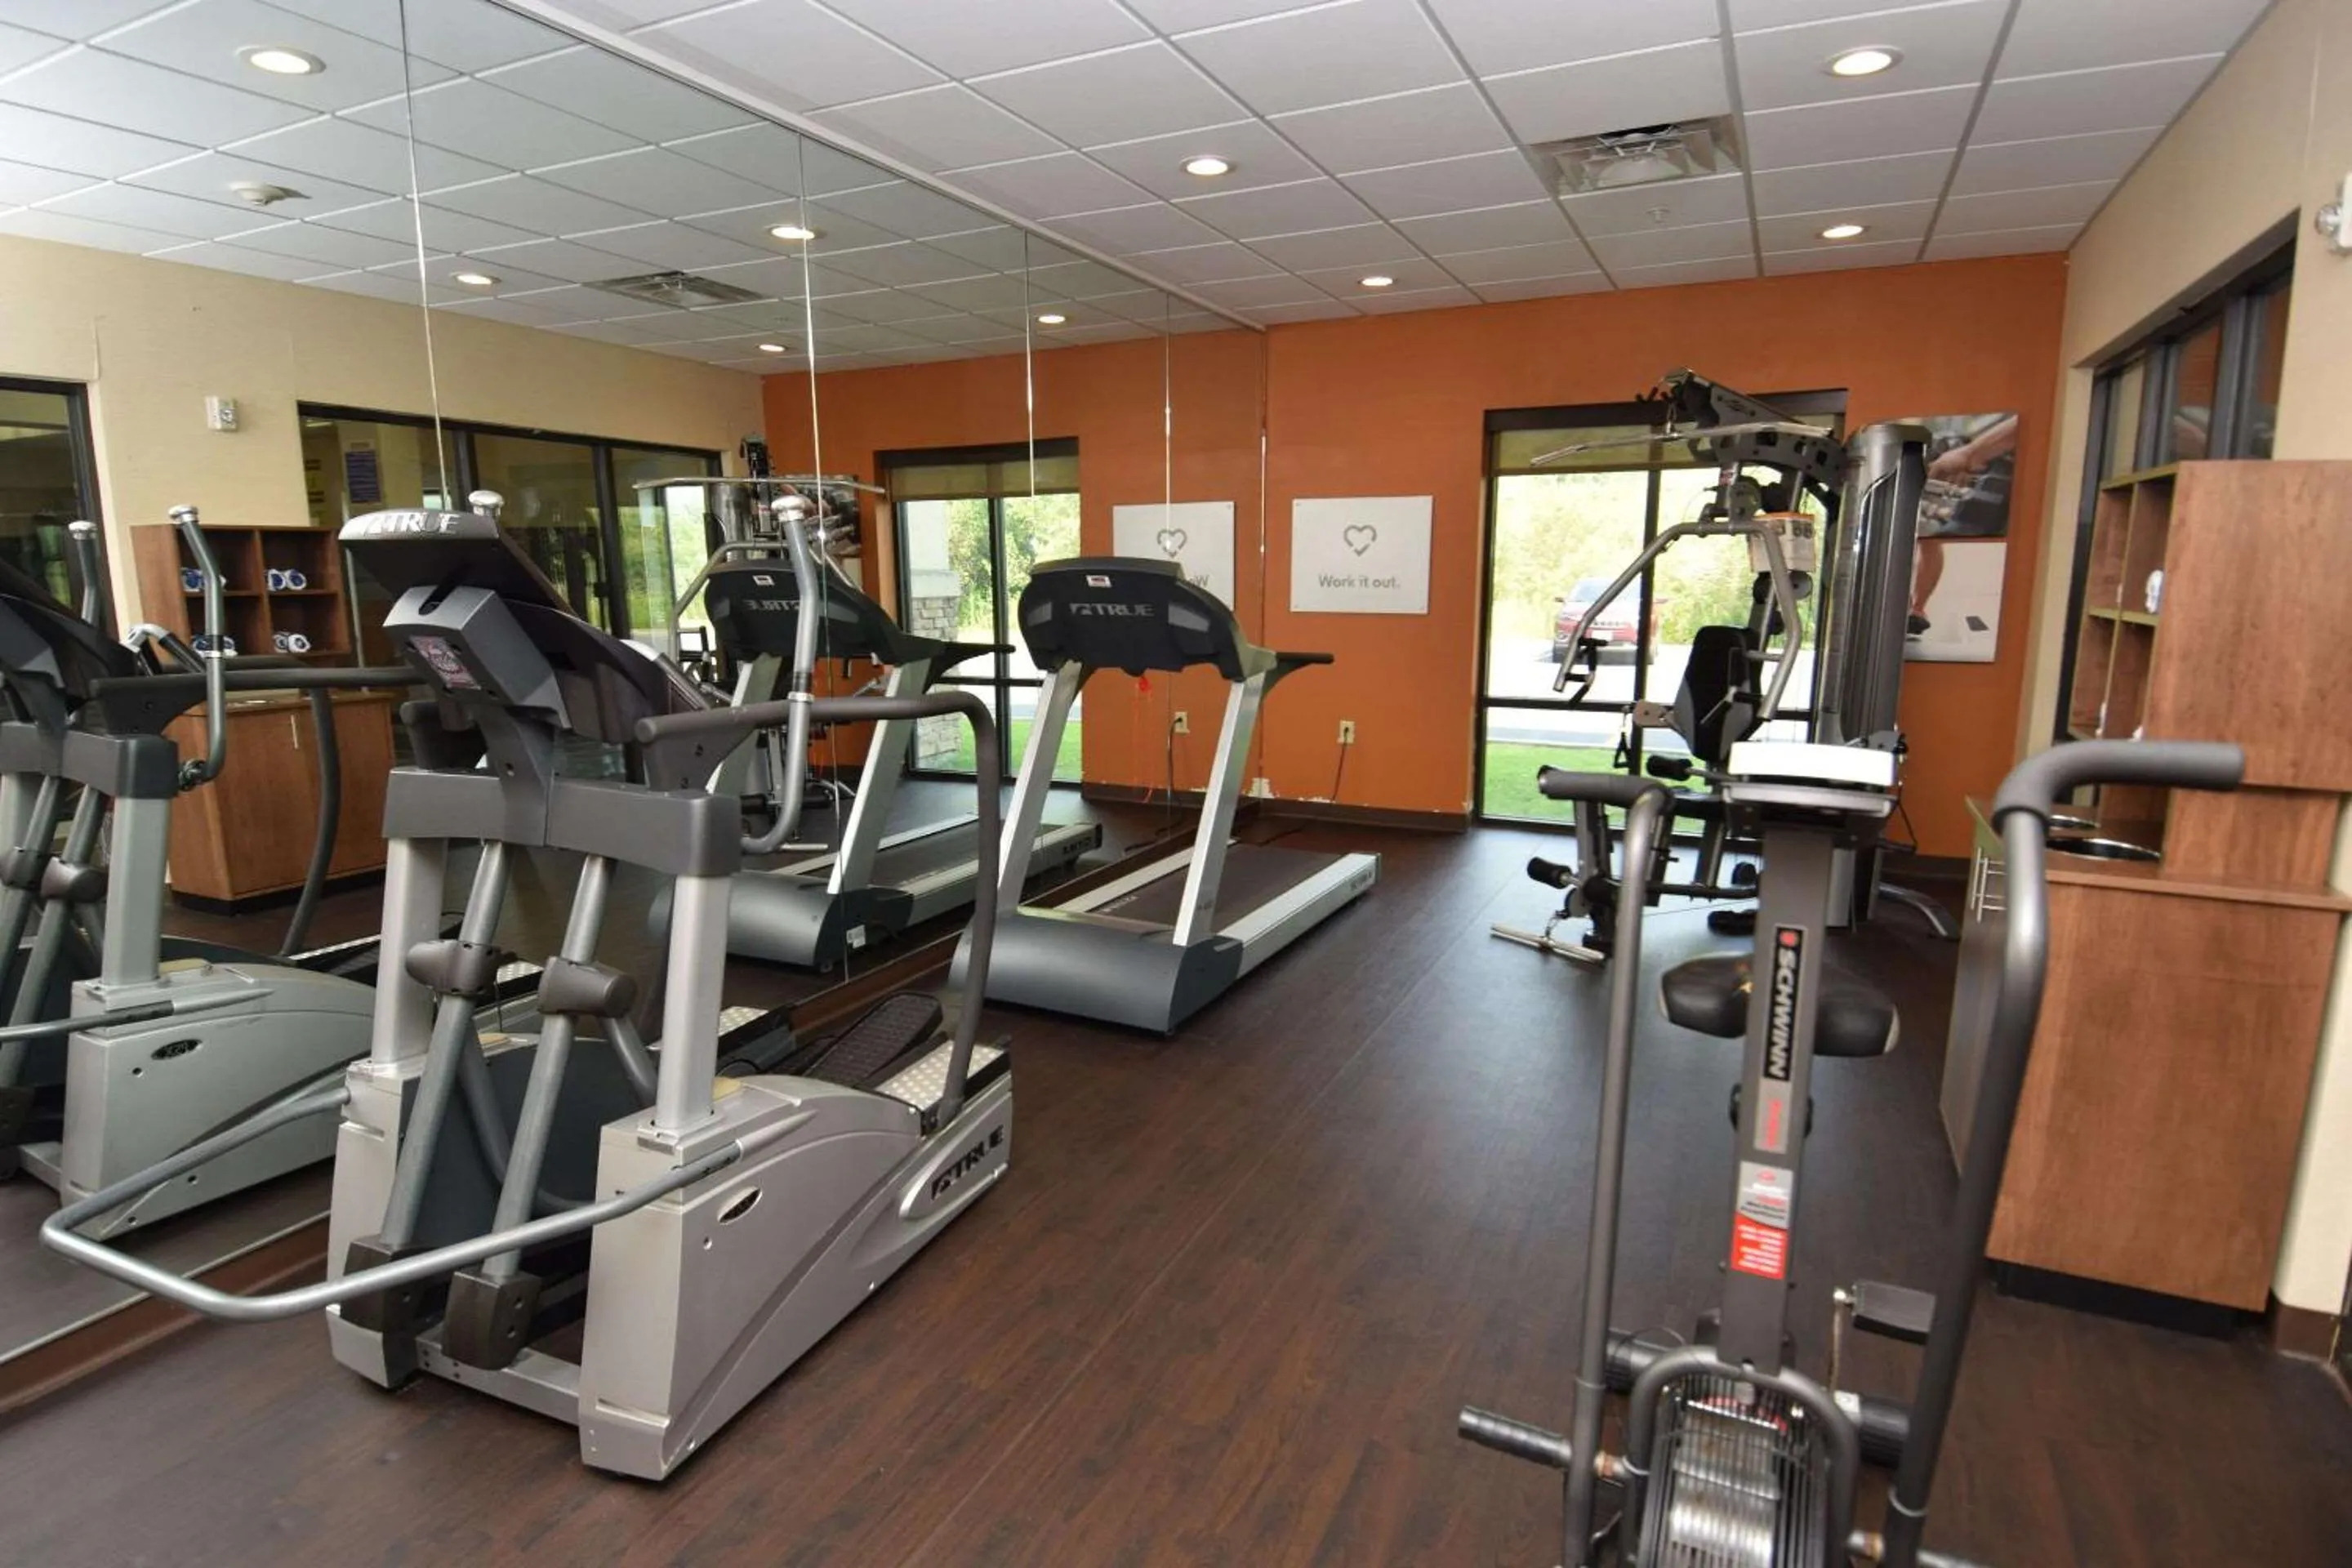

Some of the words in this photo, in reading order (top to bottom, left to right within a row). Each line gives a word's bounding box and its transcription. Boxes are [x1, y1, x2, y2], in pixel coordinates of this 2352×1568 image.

[1318, 574, 1356, 588] Work
[1359, 575, 1369, 588] it
[1372, 576, 1401, 589] out.
[1091, 603, 1155, 617] TRUE
[1767, 948, 1797, 1078] SCHWINN
